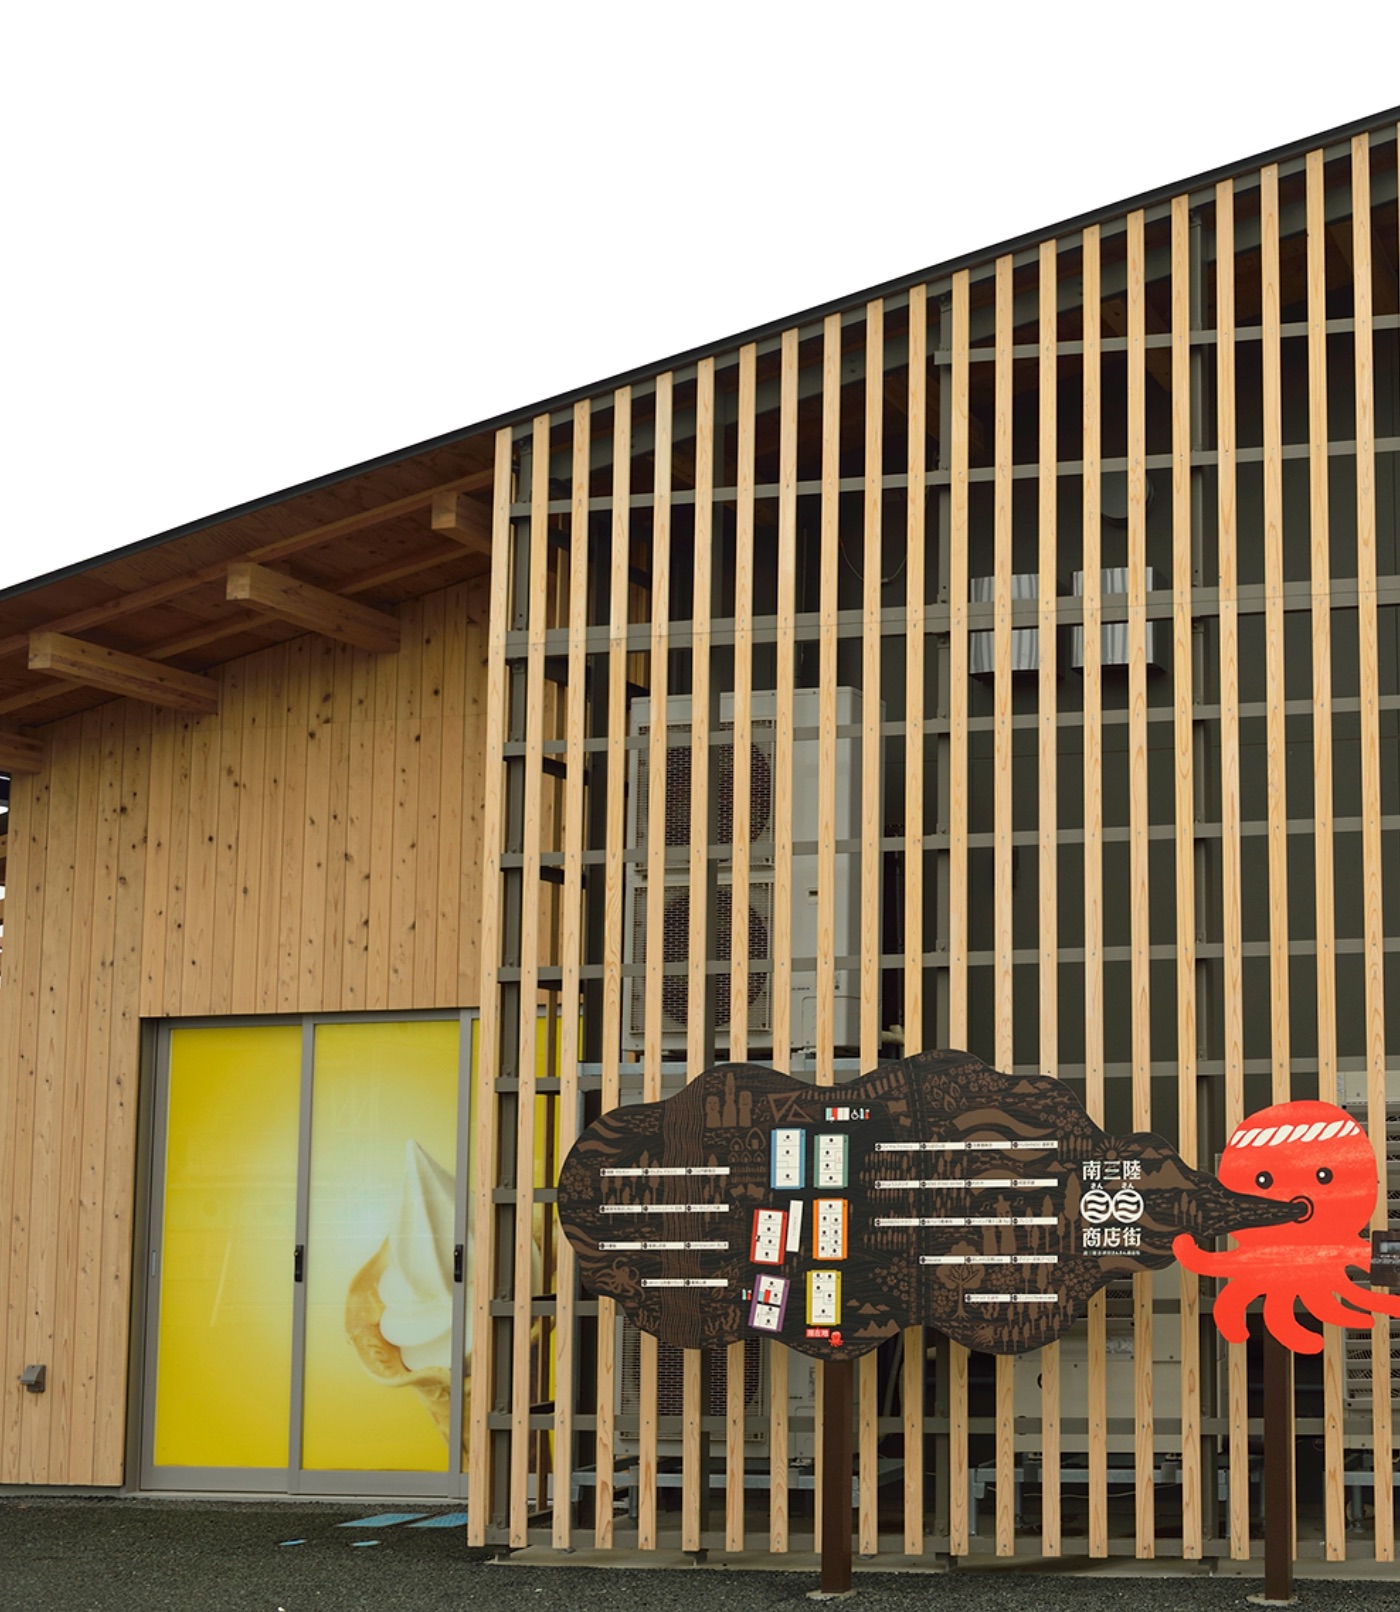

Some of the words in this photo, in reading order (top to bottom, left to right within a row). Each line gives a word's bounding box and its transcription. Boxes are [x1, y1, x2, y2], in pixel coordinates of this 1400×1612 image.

[1082, 1160, 1142, 1180] 南三陸
[1090, 1182, 1104, 1190] さん
[1121, 1182, 1135, 1190] さん
[1082, 1227, 1142, 1248] 商店街
